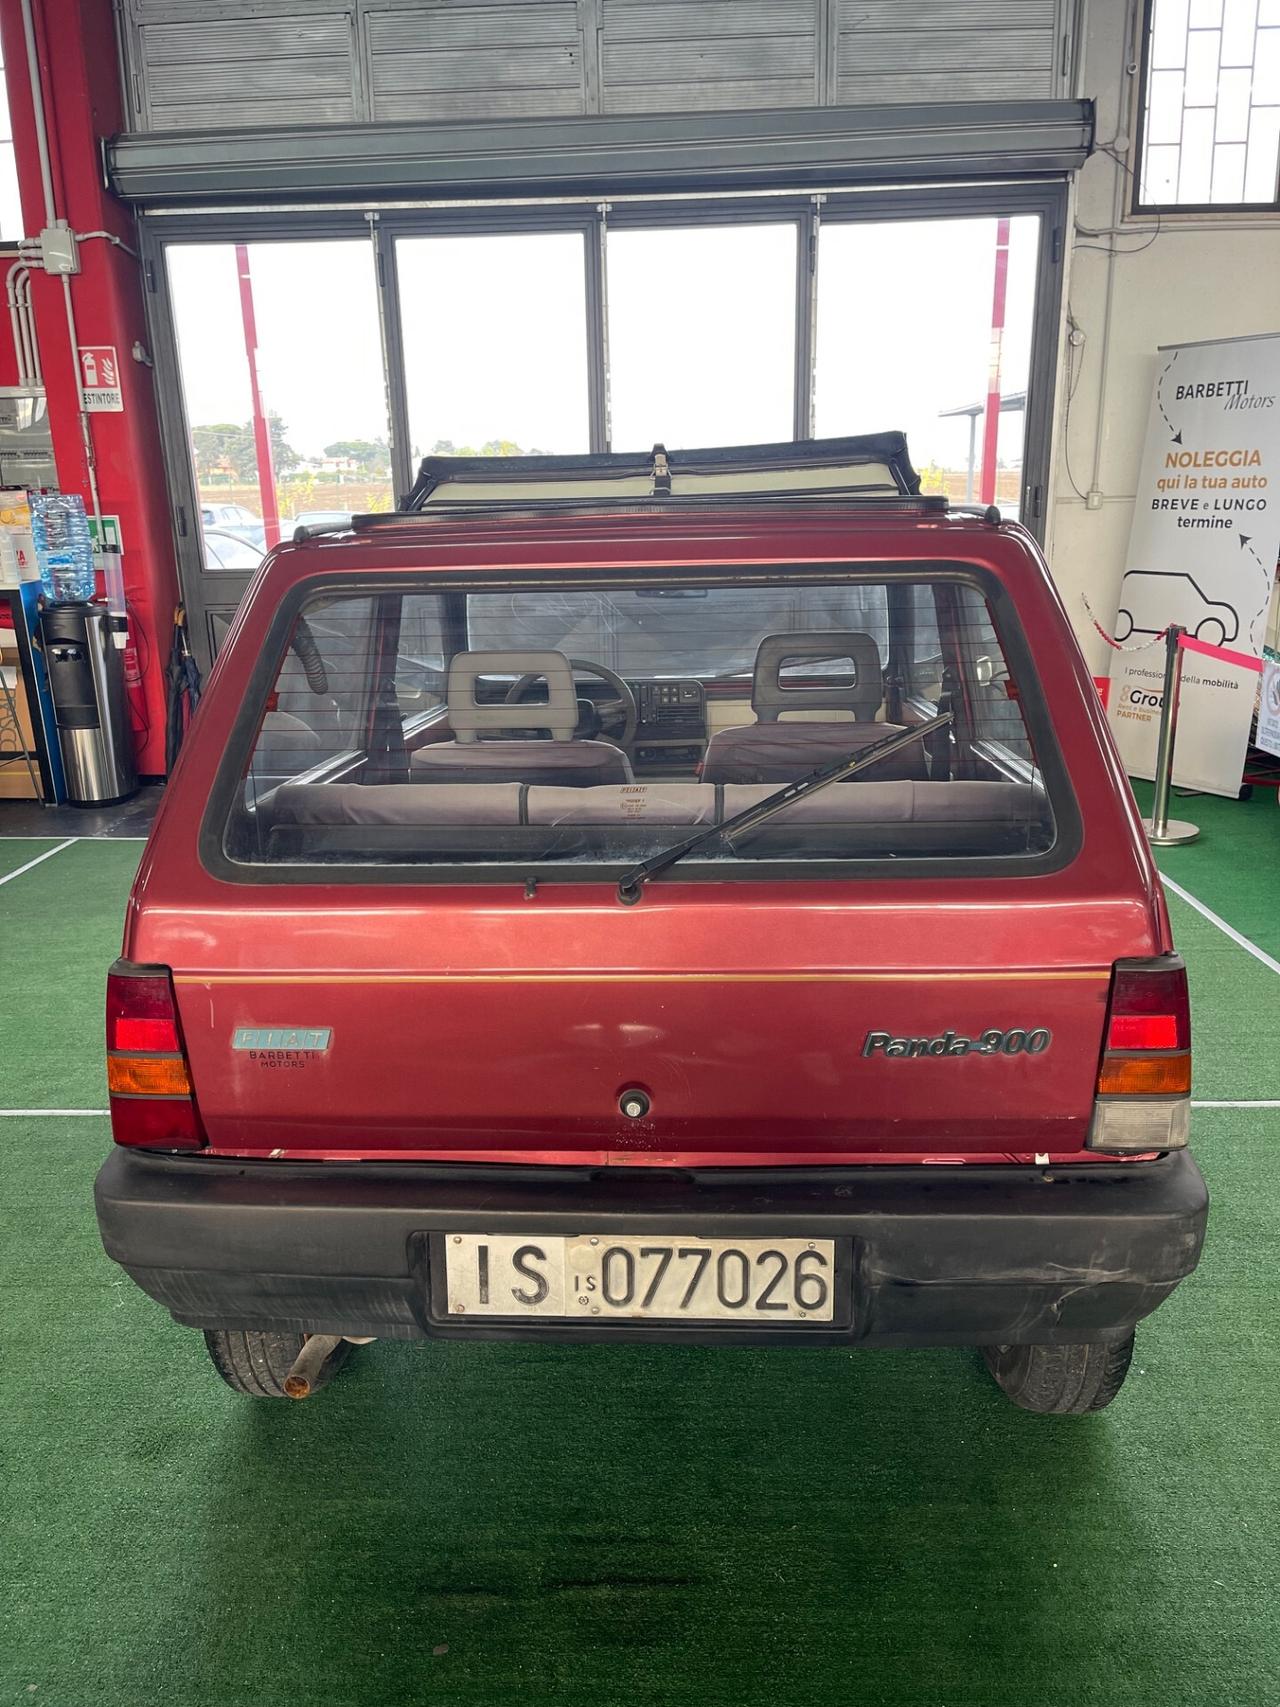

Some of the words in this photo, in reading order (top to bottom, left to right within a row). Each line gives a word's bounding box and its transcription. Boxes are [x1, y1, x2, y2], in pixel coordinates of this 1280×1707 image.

[1175, 380, 1249, 400] BARBETTI
[83, 392, 121, 405] ESTINTORE
[1223, 394, 1276, 411] Motors
[1165, 450, 1262, 468] NOLEGGIA
[1157, 474, 1181, 492] qui
[1184, 475, 1198, 489] la
[1202, 476, 1228, 489] tua
[1231, 475, 1268, 489] auto
[1151, 499, 1199, 510] BREVE
[1203, 501, 1209, 510] e
[1214, 499, 1267, 511] LUNGO
[1177, 515, 1233, 529] termine
[1181, 674, 1201, 685] della
[1202, 678, 1239, 690] mobilità
[1116, 710, 1152, 722] PARTNER
[240, 1031, 324, 1048] FIAT
[249, 1050, 315, 1060] BARBETTI
[261, 1060, 305, 1068] MOTORS
[601, 1246, 828, 1310] 077026
